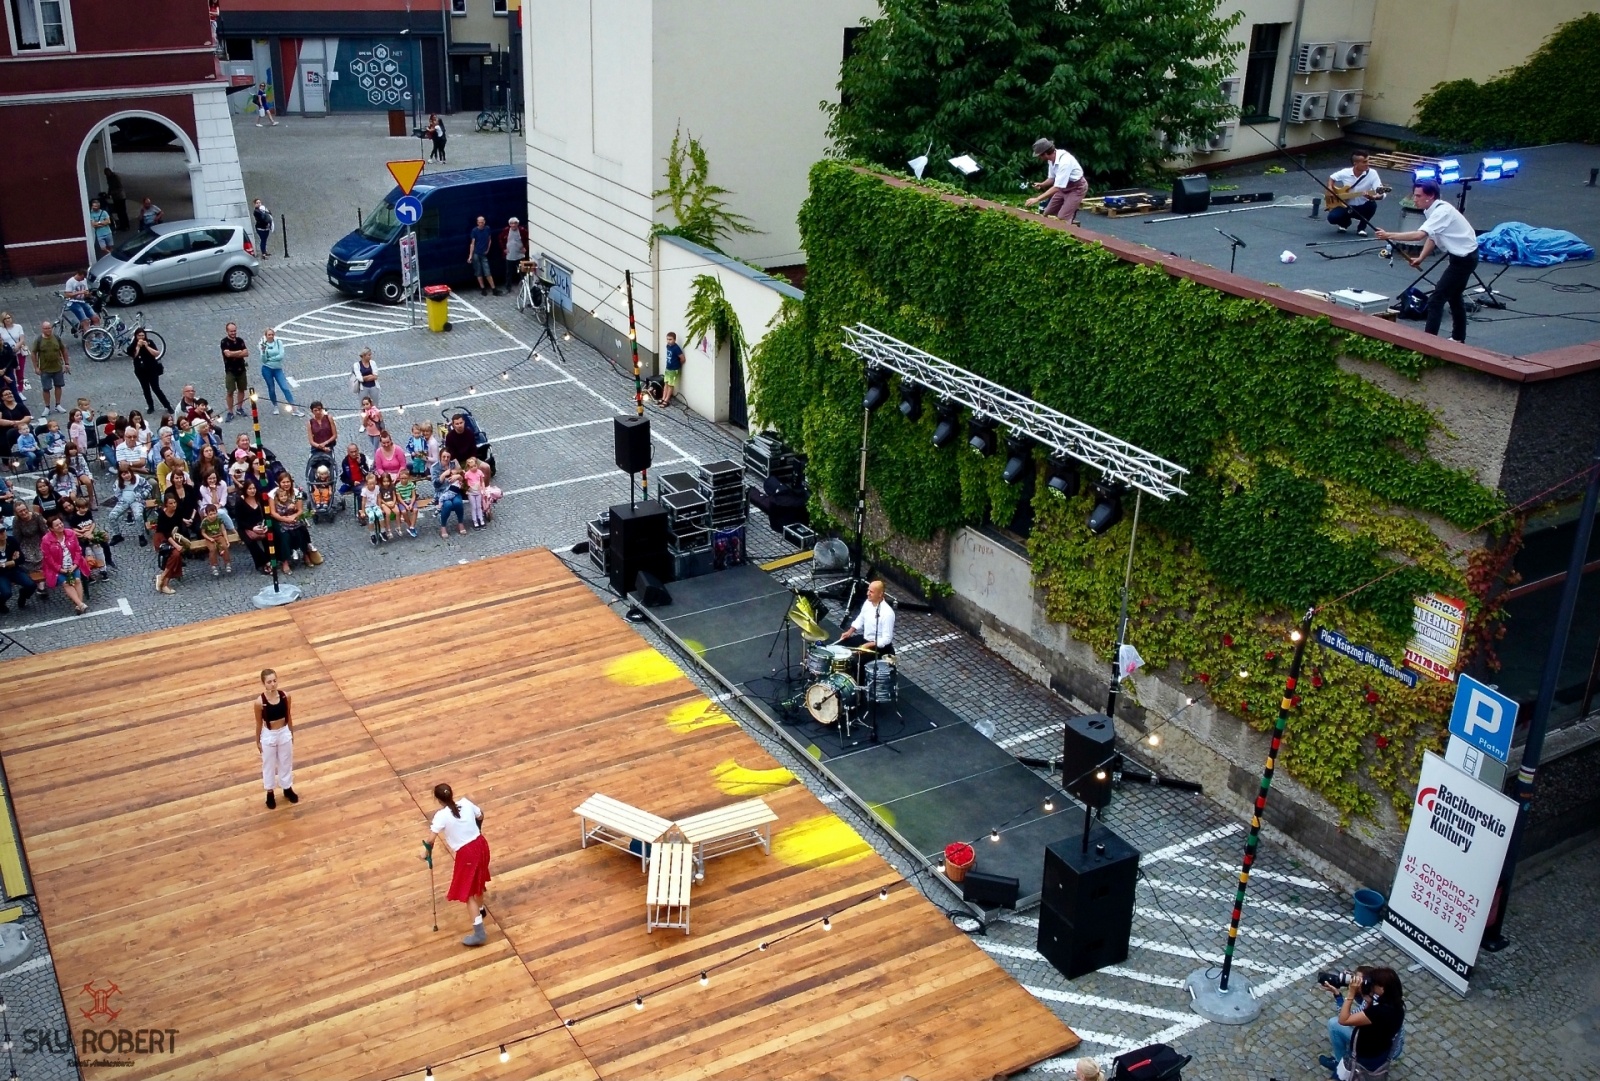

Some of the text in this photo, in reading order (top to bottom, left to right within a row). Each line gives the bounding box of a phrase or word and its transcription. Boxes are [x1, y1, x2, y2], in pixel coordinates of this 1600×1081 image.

[1320, 628, 1335, 646] Plac
[1413, 606, 1461, 637] NTERNET
[1463, 687, 1504, 736] P
[1478, 737, 1505, 758] Płatny
[1437, 783, 1507, 838] Raciborskie
[1429, 814, 1473, 854] Kultury
[1404, 864, 1477, 917] 47-400 Racibórz
[1406, 854, 1480, 907] ul. Chopina 21
[1413, 881, 1468, 924] 32 412 32 40
[1410, 890, 1466, 934] 32 415 31 72
[1388, 911, 1469, 976] www.rck.com.pl
